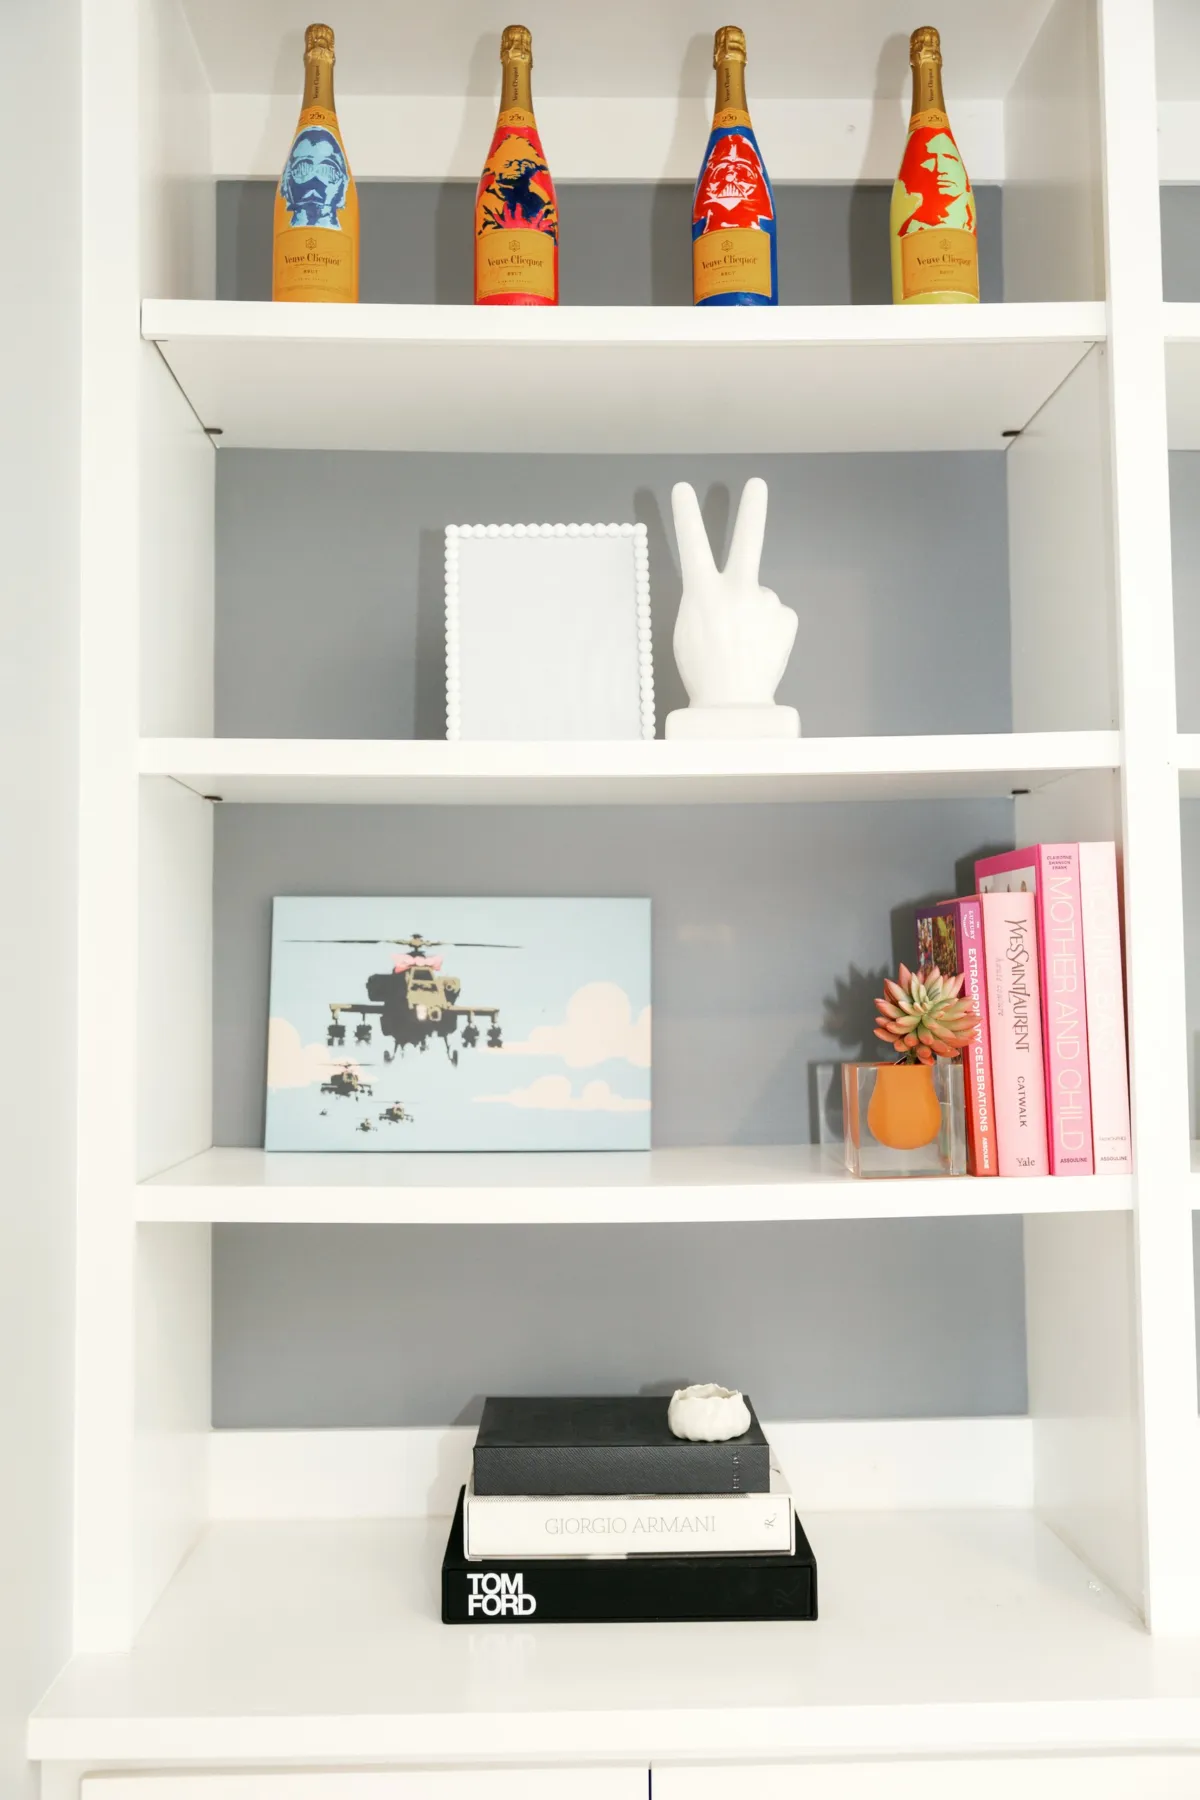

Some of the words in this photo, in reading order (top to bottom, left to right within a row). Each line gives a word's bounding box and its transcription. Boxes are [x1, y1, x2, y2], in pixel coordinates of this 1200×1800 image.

[284, 254, 305, 264] Veuve
[307, 252, 341, 268] Clicquot
[487, 257, 509, 267] Veuve
[511, 254, 544, 268] Clicquot
[701, 259, 722, 269] Veuve
[723, 254, 758, 267] Clicquot
[916, 256, 940, 266] Veuve
[942, 253, 972, 266] Clicquot
[968, 910, 976, 940] LUXURY
[1050, 876, 1077, 993] MOTHER
[1055, 1001, 1080, 1060] AND
[974, 1047, 988, 1133] CELEBRATIONS
[1017, 1075, 1028, 1127] CATWALK
[1057, 1069, 1084, 1151] CHILD
[981, 1137, 989, 1169] ASSOULINE
[1016, 1157, 1036, 1167] Yale
[544, 1517, 627, 1535] GIORGIO
[632, 1516, 717, 1533] ARMANI
[467, 1573, 523, 1595] TOM
[468, 1594, 536, 1616] FORD
